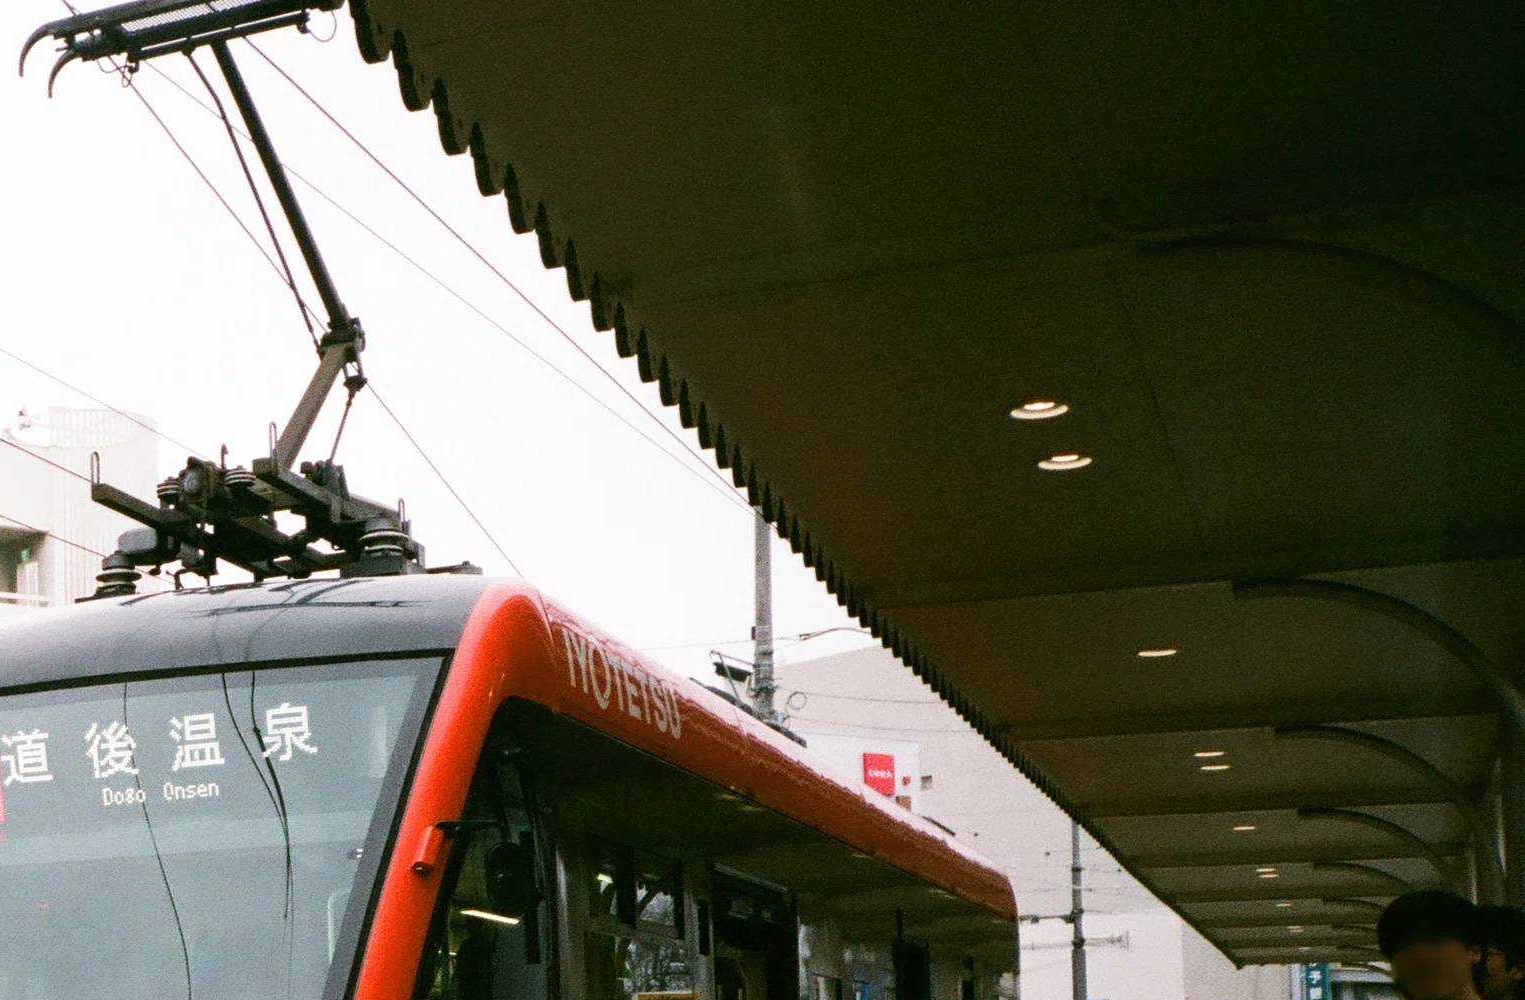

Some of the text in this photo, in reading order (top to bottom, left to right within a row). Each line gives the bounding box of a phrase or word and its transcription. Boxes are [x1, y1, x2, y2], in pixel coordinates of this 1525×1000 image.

[561, 626, 682, 739] IYOTETSU
[0, 703, 318, 786] 道後温泉
[102, 781, 220, 806] Dogo Onsen
